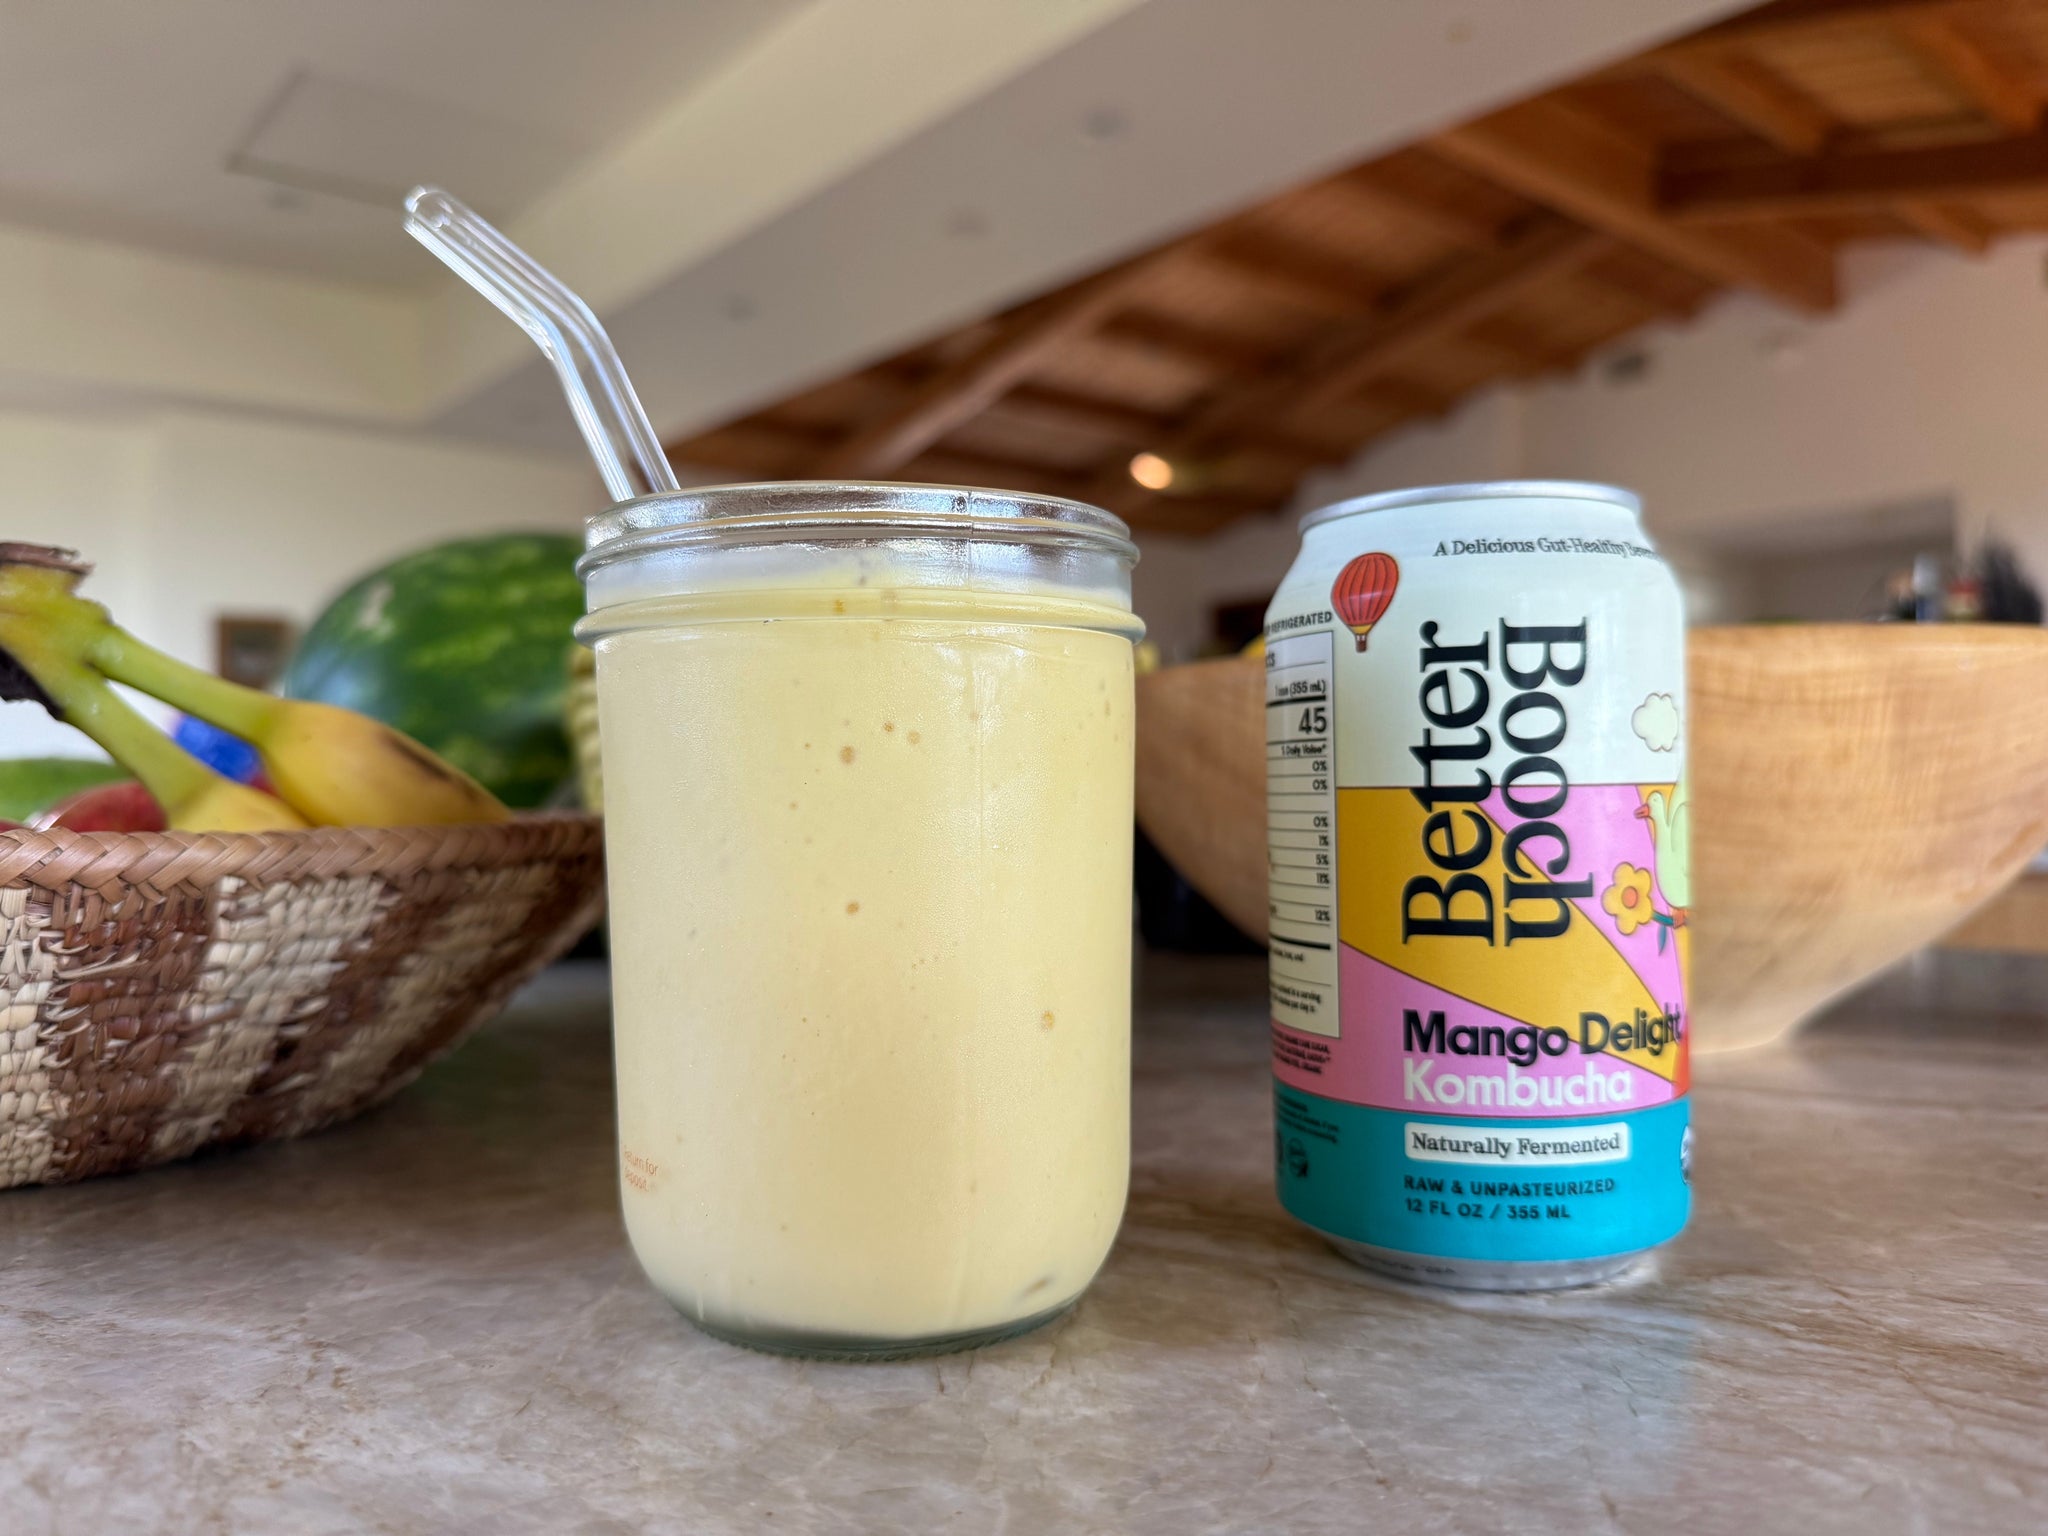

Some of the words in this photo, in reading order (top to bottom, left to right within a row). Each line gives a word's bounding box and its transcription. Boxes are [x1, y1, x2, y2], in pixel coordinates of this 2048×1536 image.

[1432, 541, 1448, 557] A
[1451, 538, 1535, 556] Delicious
[1536, 537, 1627, 558] Gut-Healthy
[1298, 706, 1328, 735] 45
[1312, 760, 1327, 772] 0%
[1312, 779, 1328, 791] 0%
[1401, 620, 1494, 947] Better
[1498, 617, 1594, 947] Booch
[1313, 816, 1328, 828] 0%
[1402, 1008, 1570, 1067] Mango
[1578, 1002, 1682, 1057] Delight
[1402, 1058, 1634, 1107] Kombucha
[1411, 1131, 1512, 1159] Naturally
[1515, 1132, 1620, 1156] Fermented
[1403, 1174, 1444, 1193] RAW
[1450, 1180, 1463, 1195] &
[1470, 1177, 1615, 1197] UNPASTEURIZED
[1405, 1197, 1422, 1213] 12
[1429, 1200, 1450, 1216] FL
[1457, 1202, 1483, 1218] OZ
[1490, 1203, 1500, 1219] /
[1507, 1204, 1539, 1220] 355
[1546, 1204, 1571, 1219] ML
